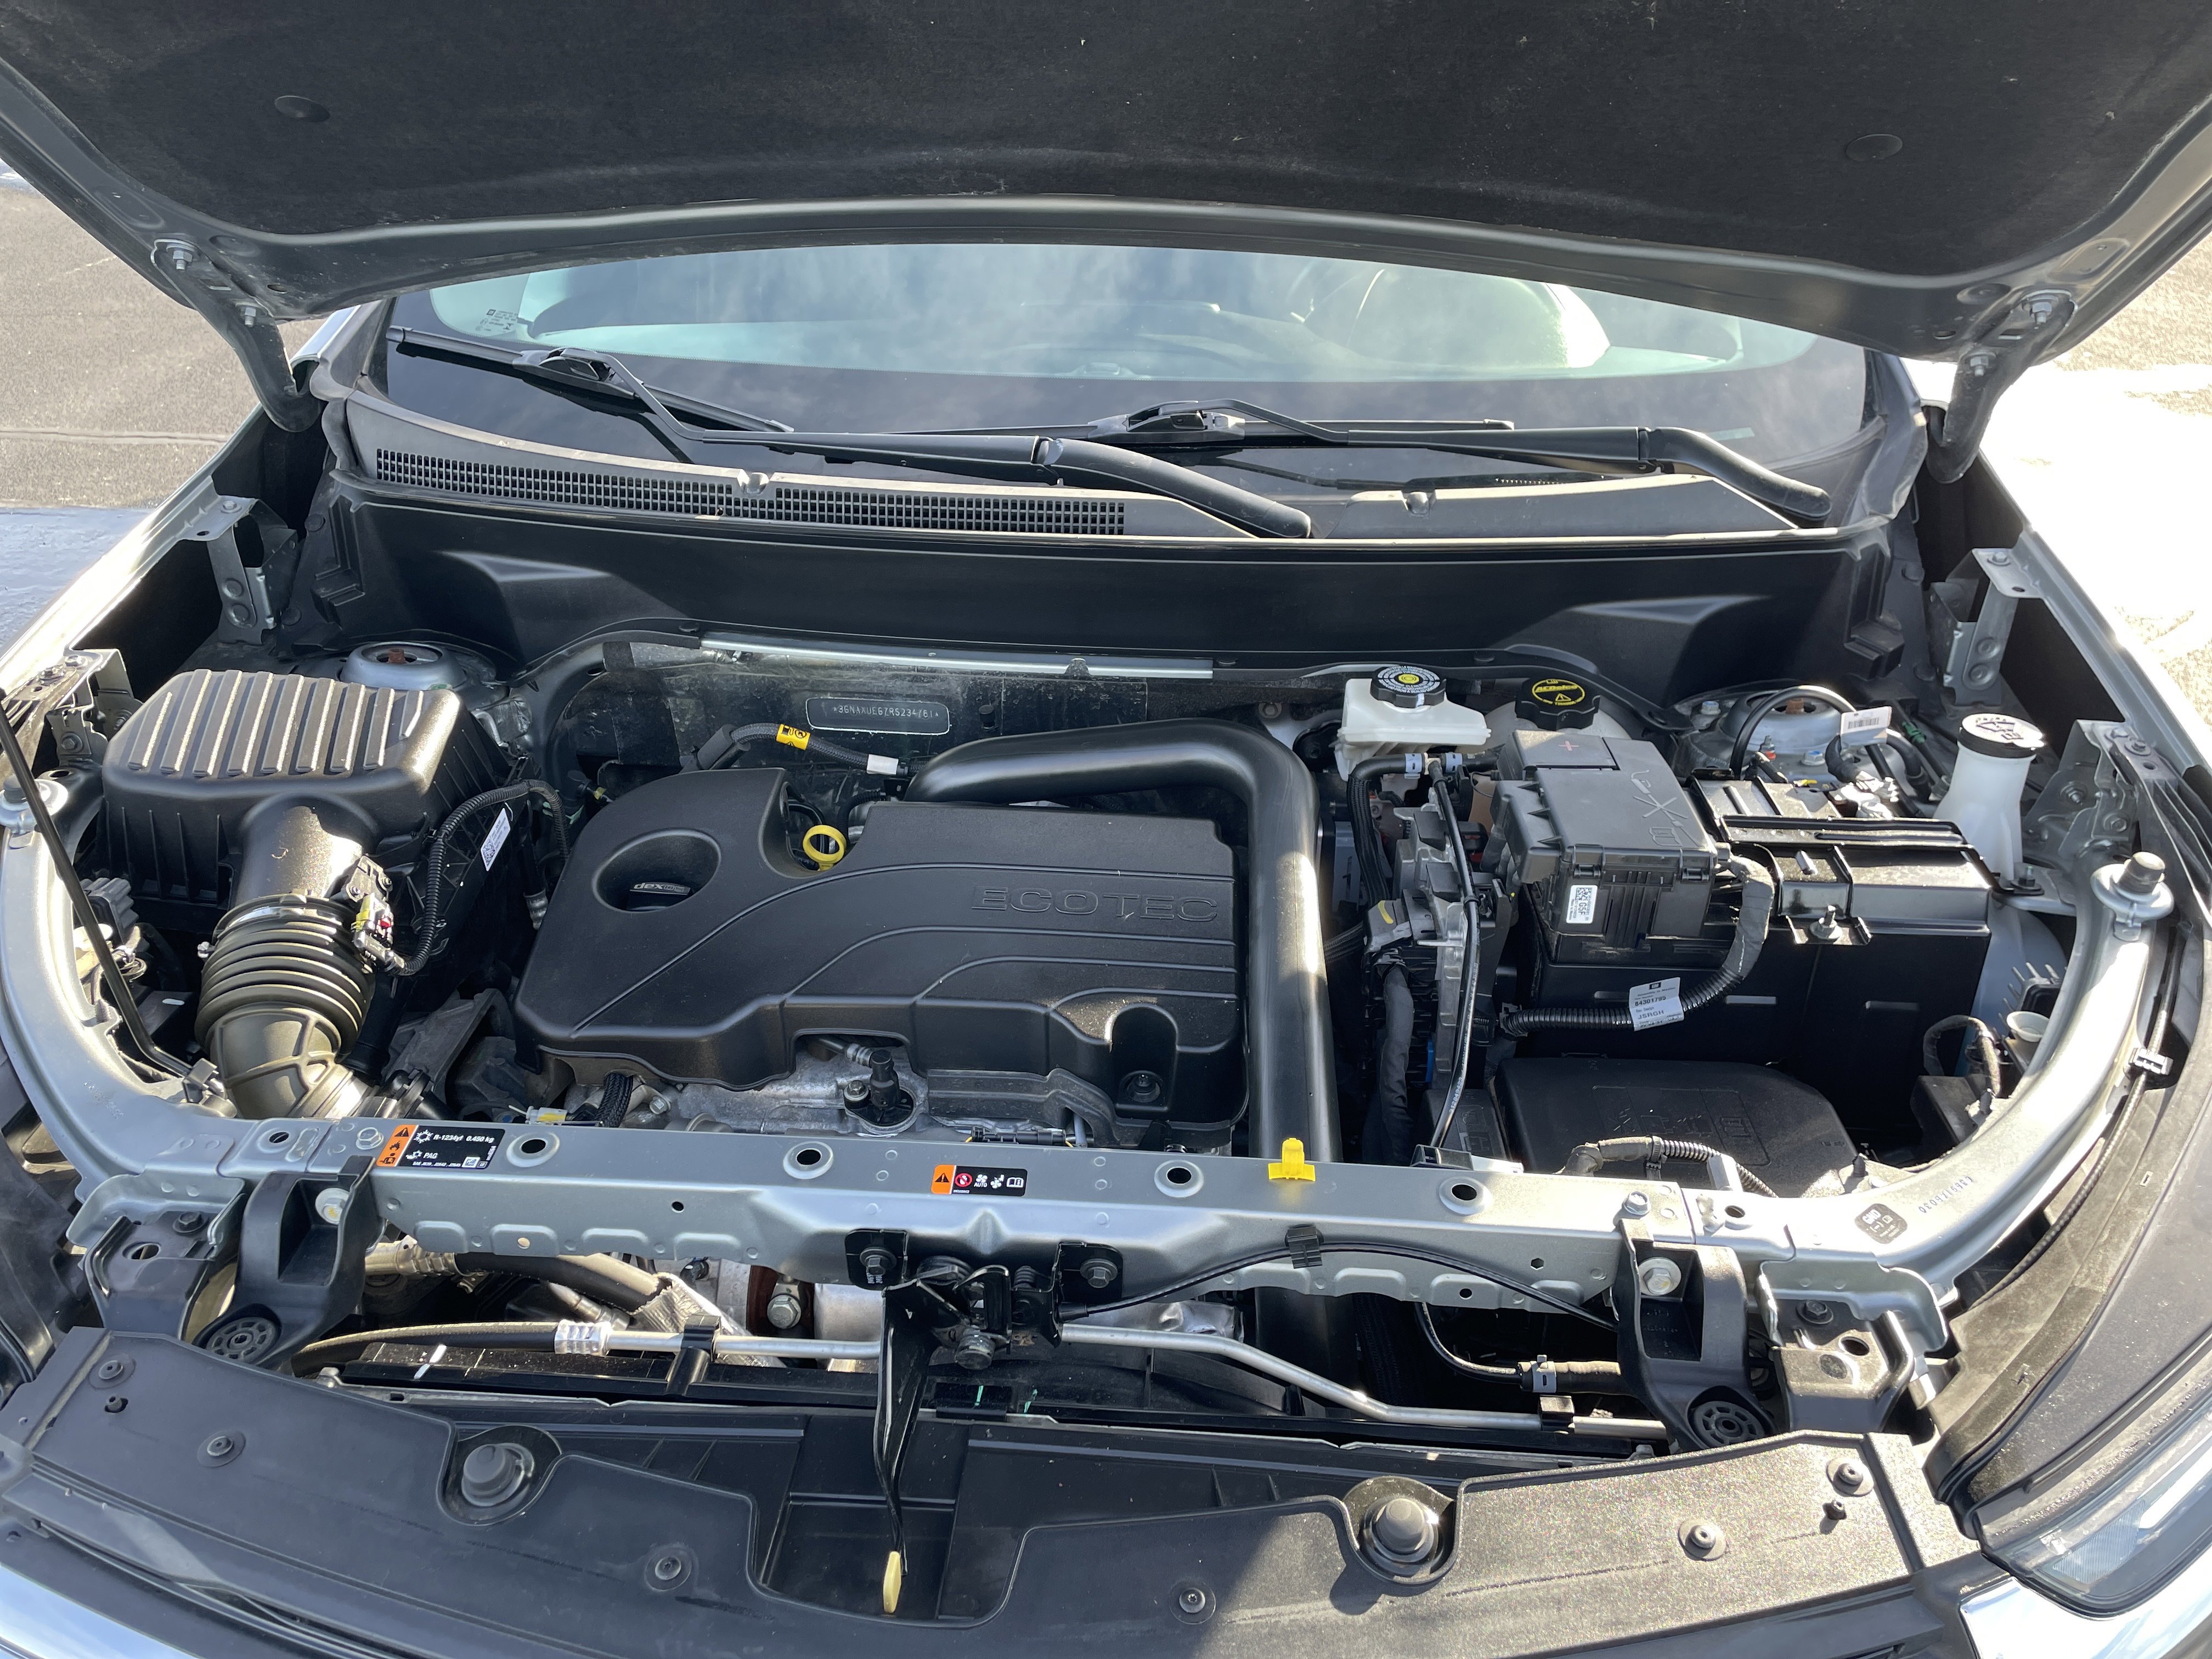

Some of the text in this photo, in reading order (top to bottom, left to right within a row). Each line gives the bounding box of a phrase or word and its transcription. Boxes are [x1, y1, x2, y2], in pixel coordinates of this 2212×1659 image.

[634, 883, 685, 891] dexos
[972, 886, 1217, 922] ECOTEC
[1578, 902, 1587, 916] G5F
